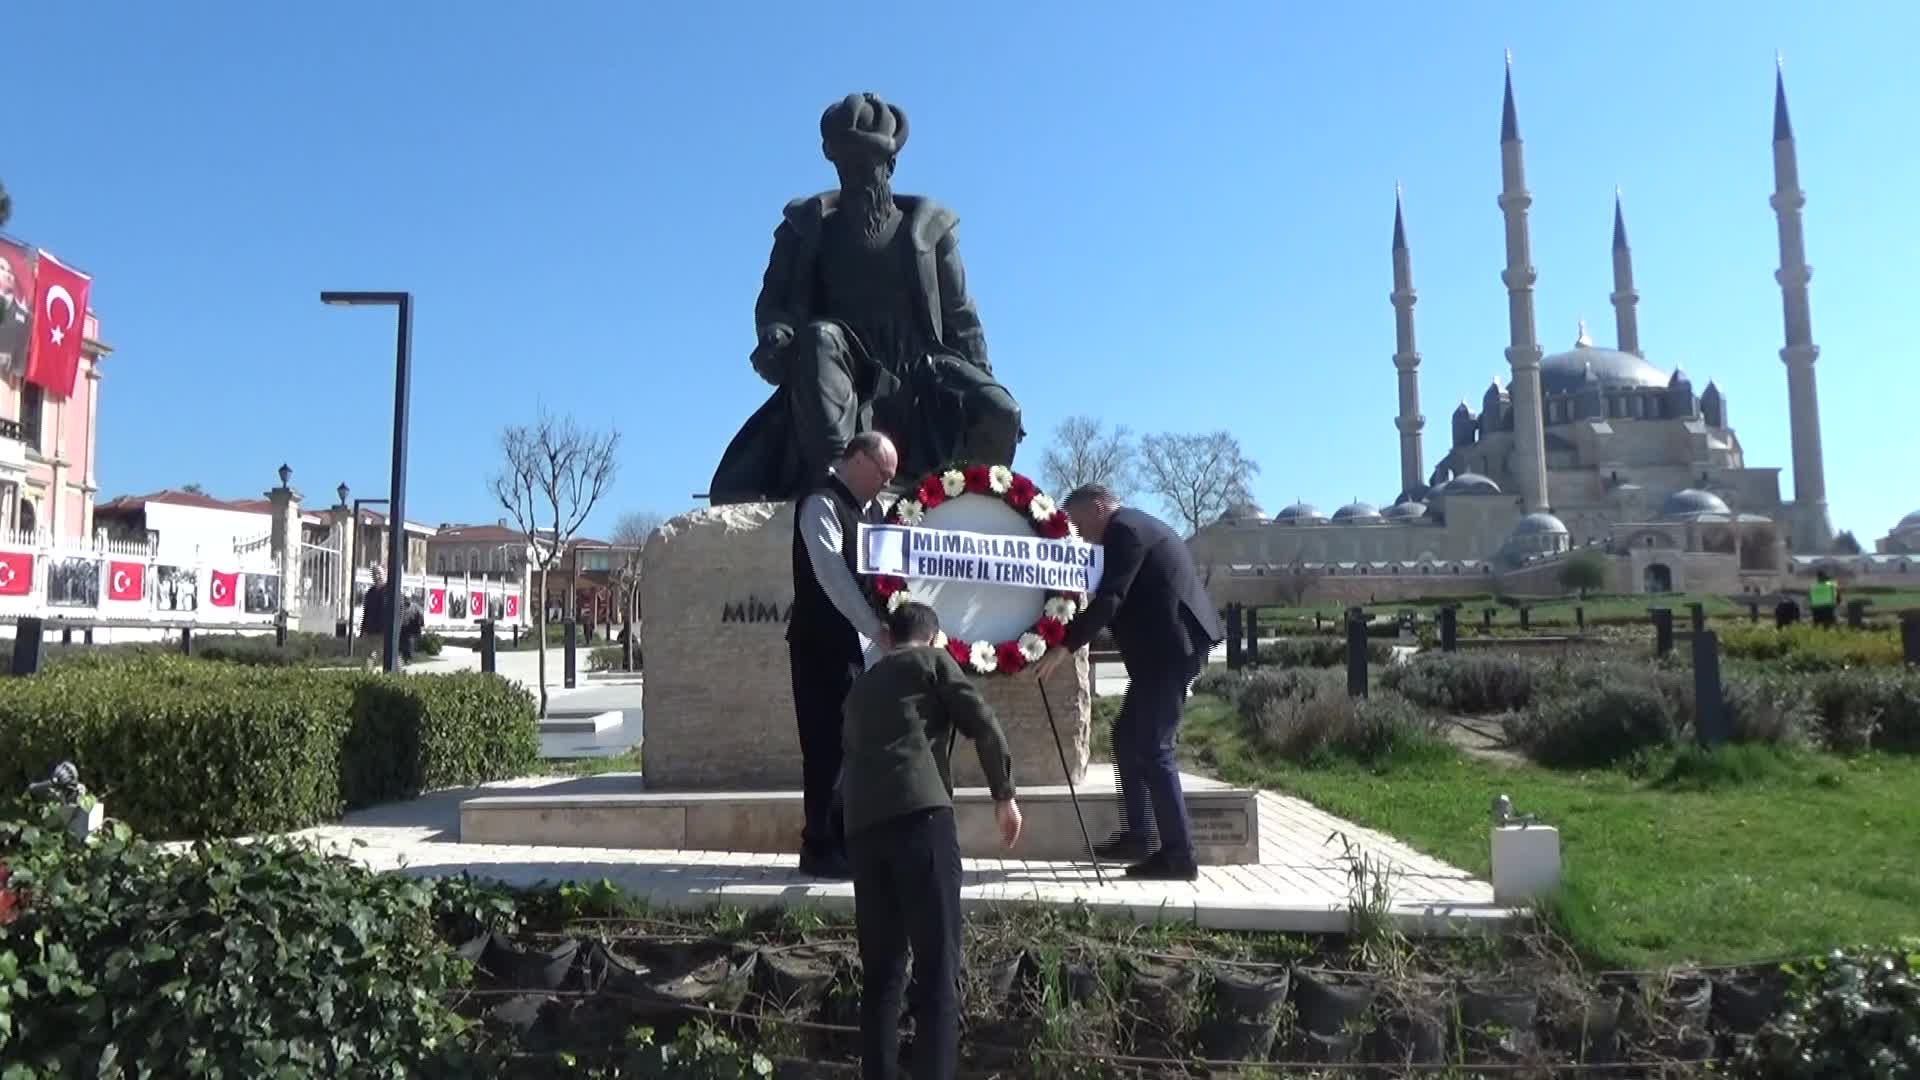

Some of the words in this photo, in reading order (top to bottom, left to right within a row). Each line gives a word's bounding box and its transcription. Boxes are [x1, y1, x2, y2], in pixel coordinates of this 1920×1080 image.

[913, 532, 1030, 559] MİMARLAR
[1036, 542, 1095, 568] ODASI
[918, 554, 974, 579] EDİRNE
[977, 557, 990, 580] İL
